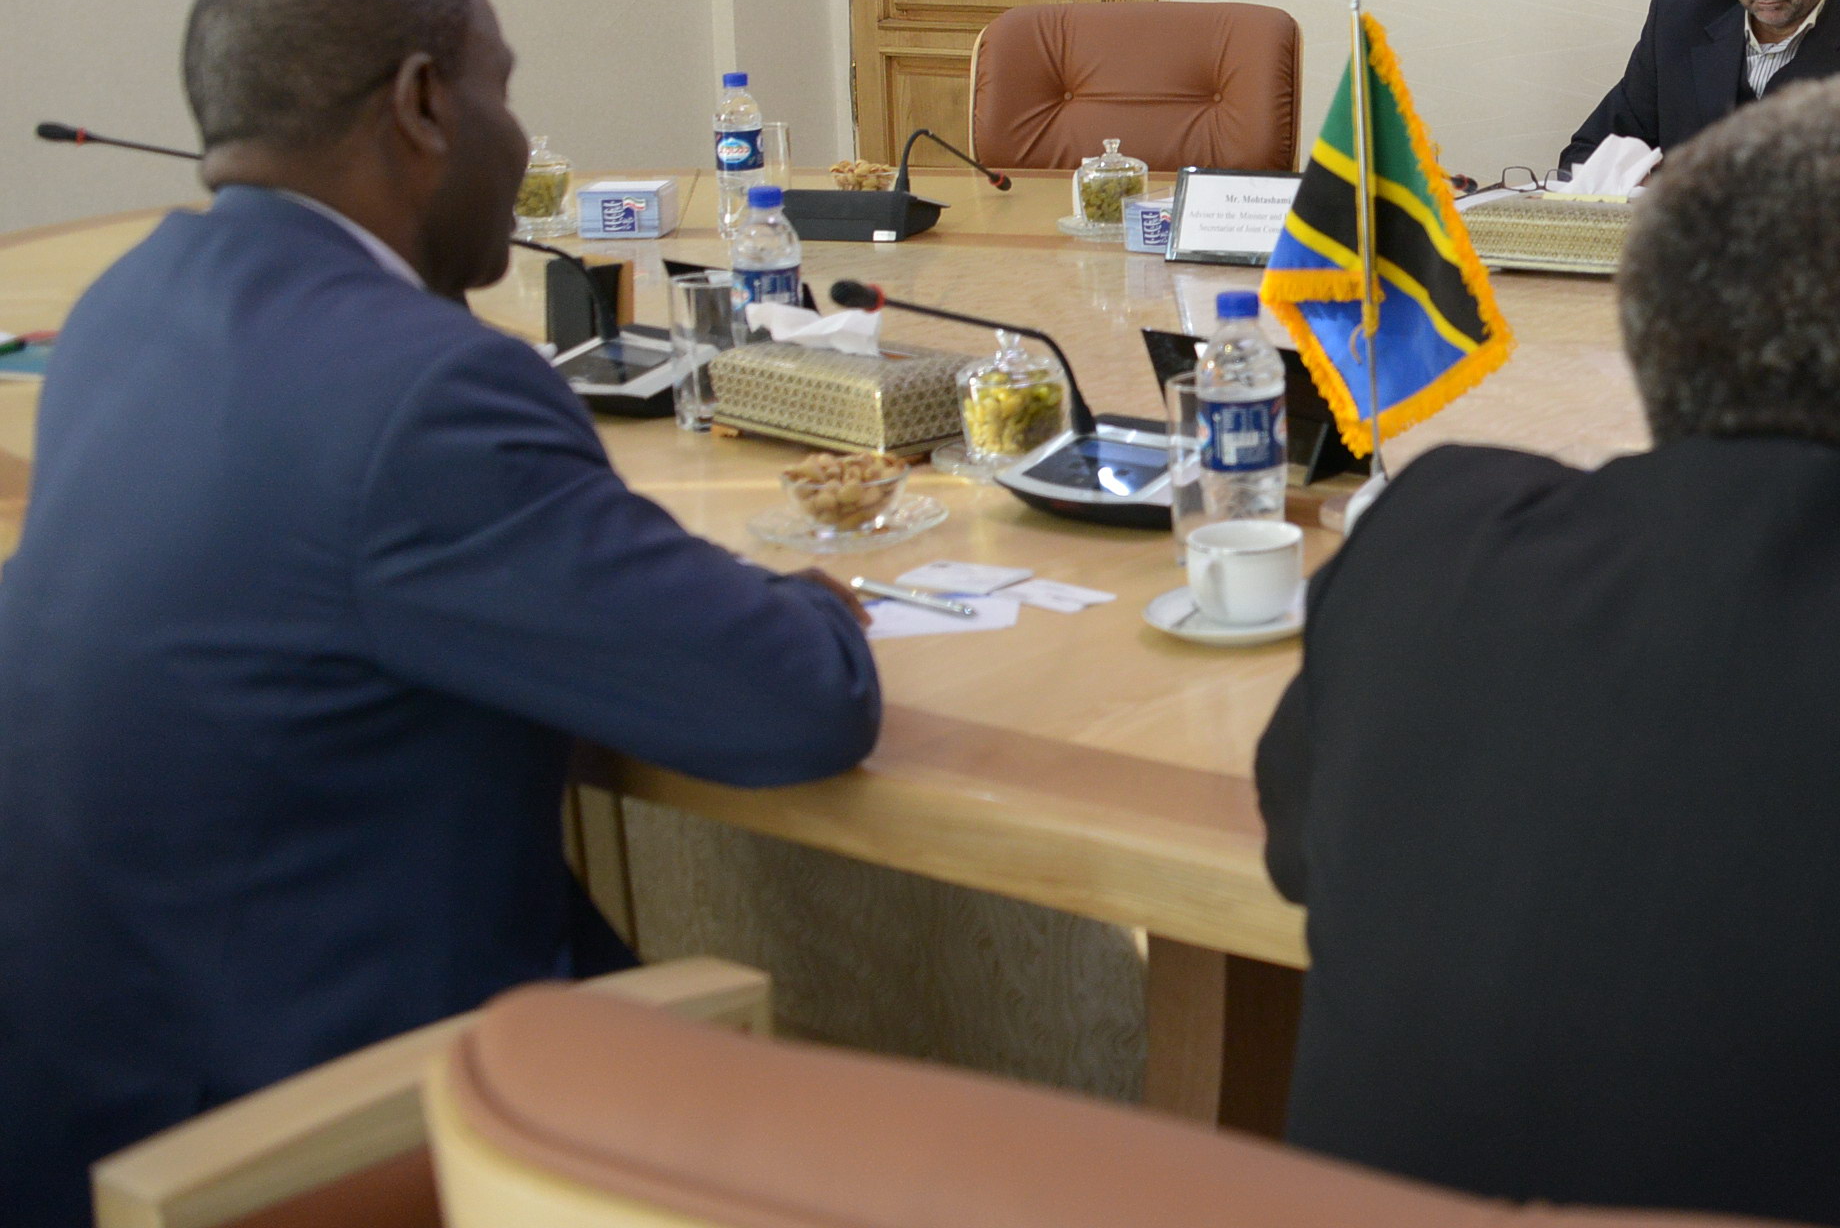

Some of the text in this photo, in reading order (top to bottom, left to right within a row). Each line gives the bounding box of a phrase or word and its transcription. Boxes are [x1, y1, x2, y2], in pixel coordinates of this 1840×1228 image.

[1225, 194, 1291, 205] Mr. Mohtashami
[1225, 211, 1236, 220] the
